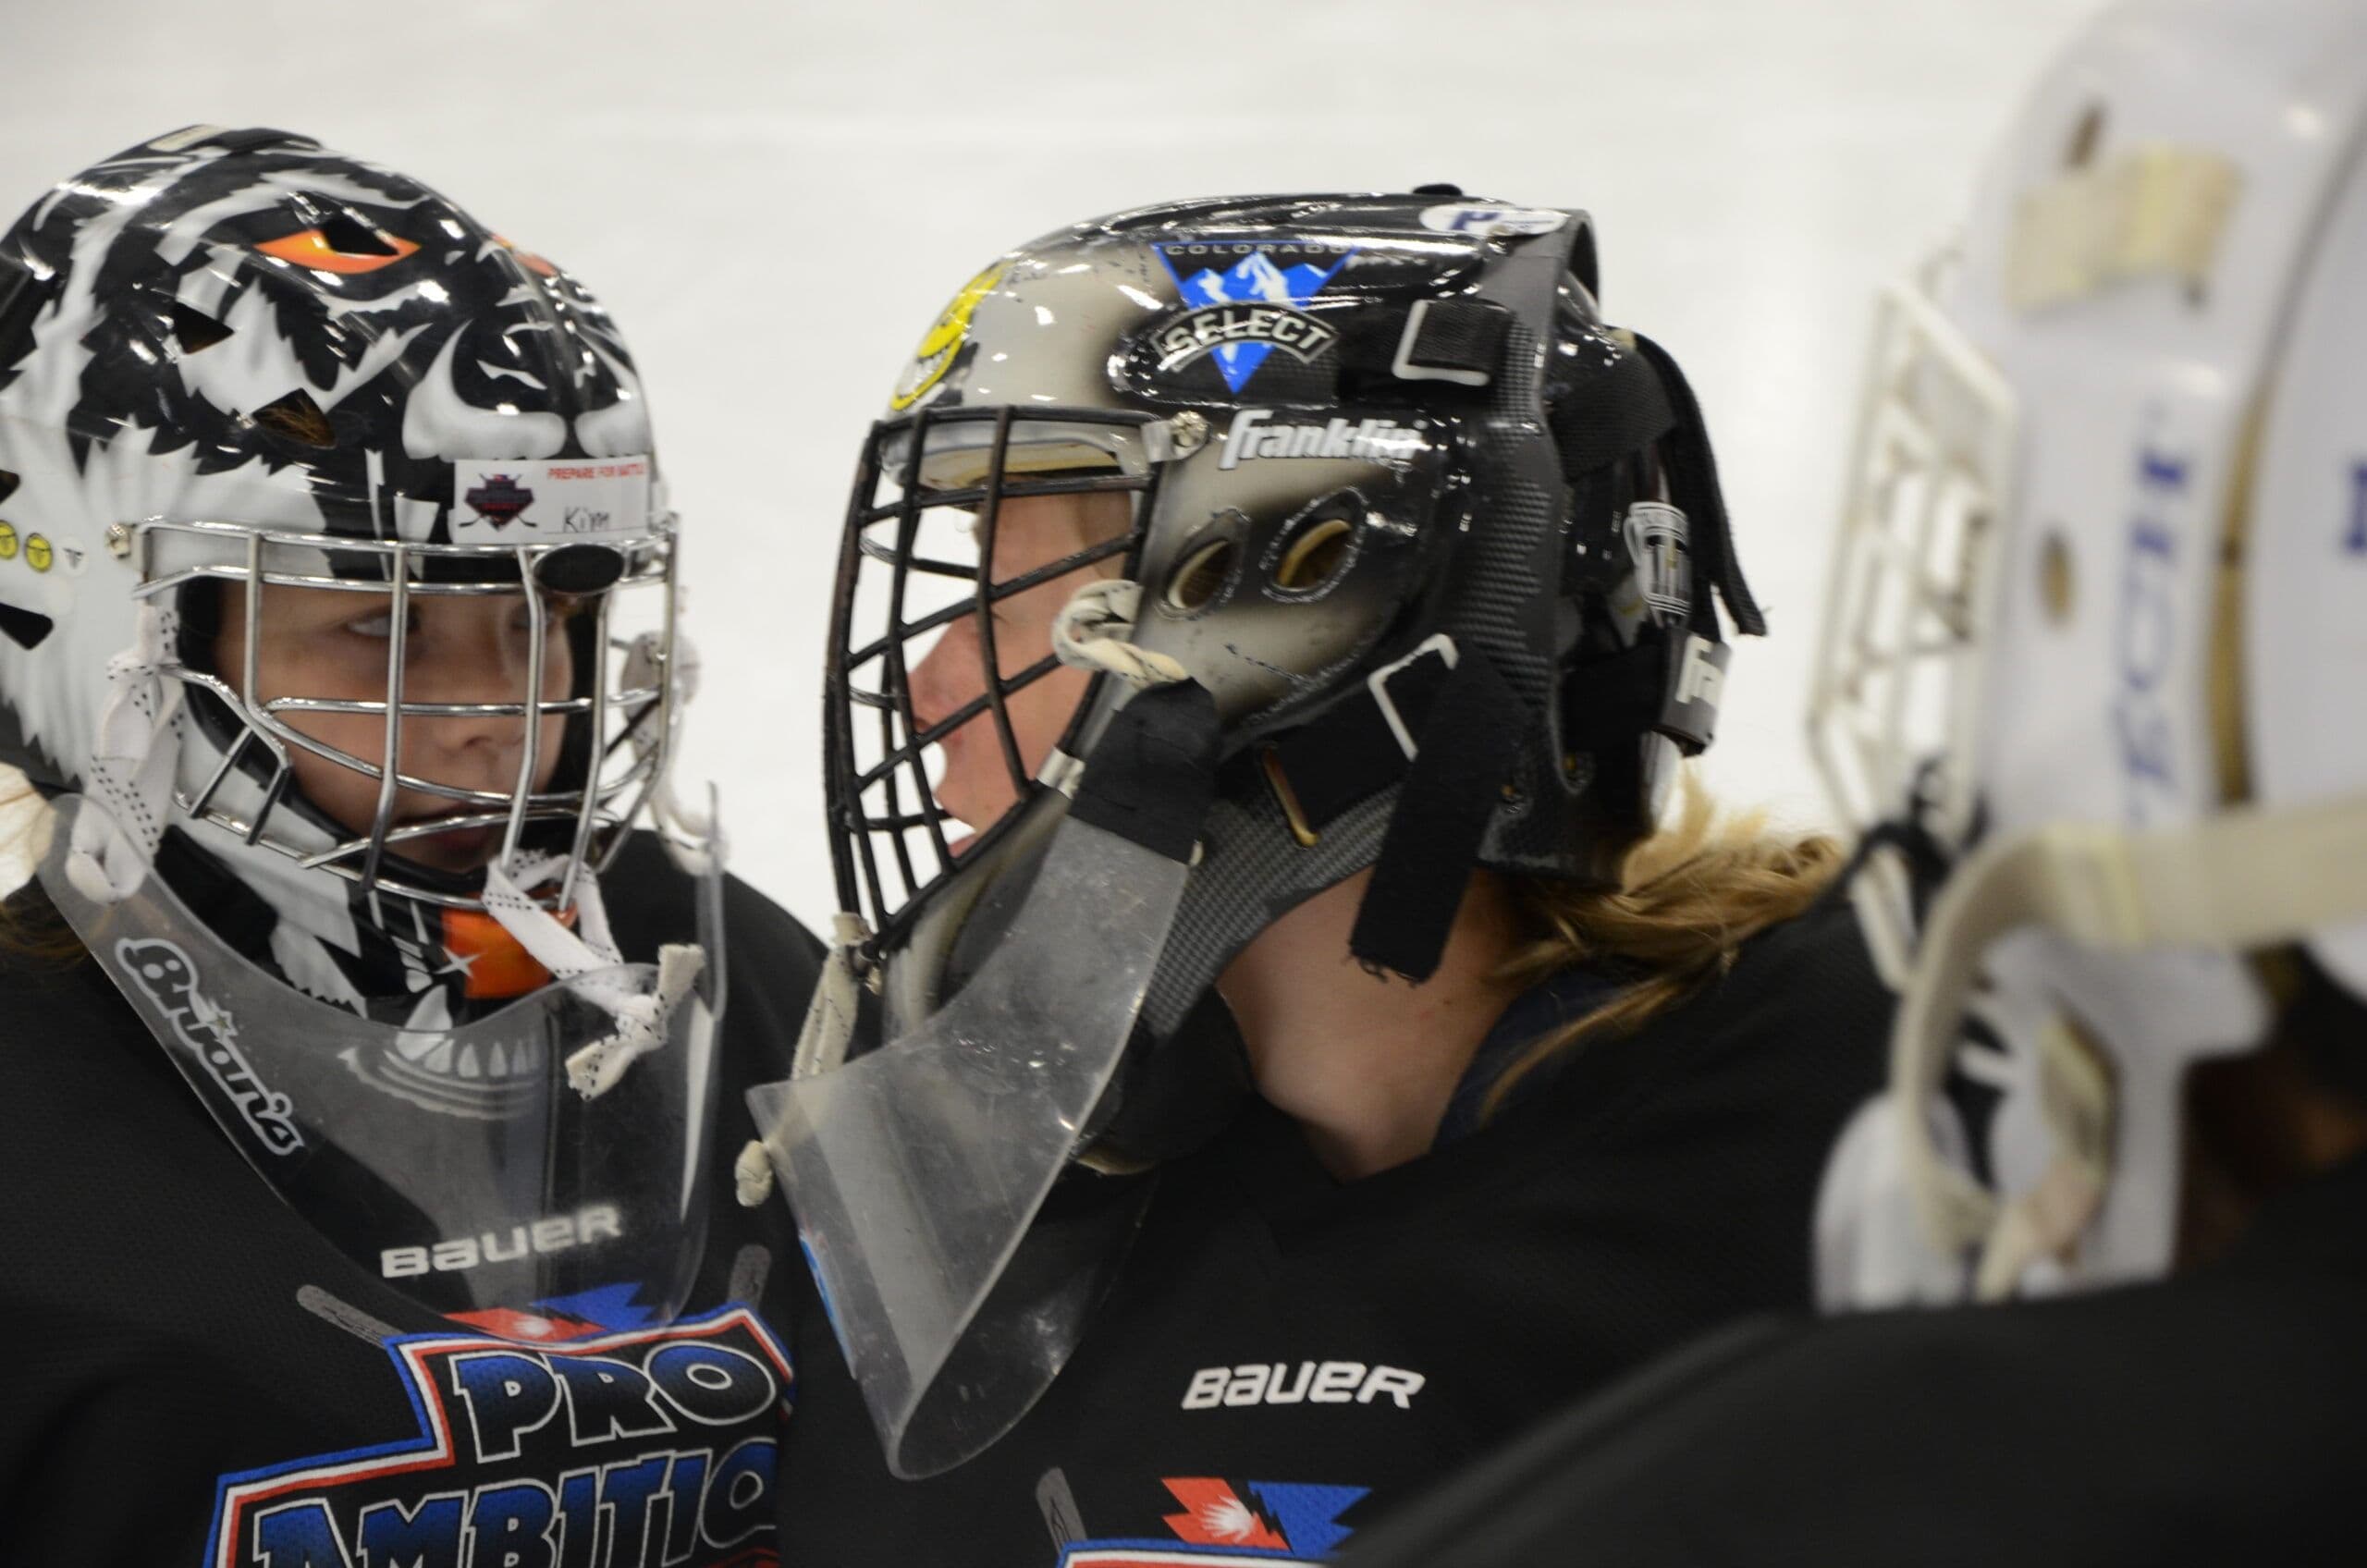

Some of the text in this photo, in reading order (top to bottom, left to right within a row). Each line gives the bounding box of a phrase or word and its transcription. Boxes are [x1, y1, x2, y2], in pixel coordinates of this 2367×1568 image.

[1165, 243, 1349, 255] COLORADO
[1161, 308, 1331, 353] SELECT
[448, 1340, 777, 1464] PRO
